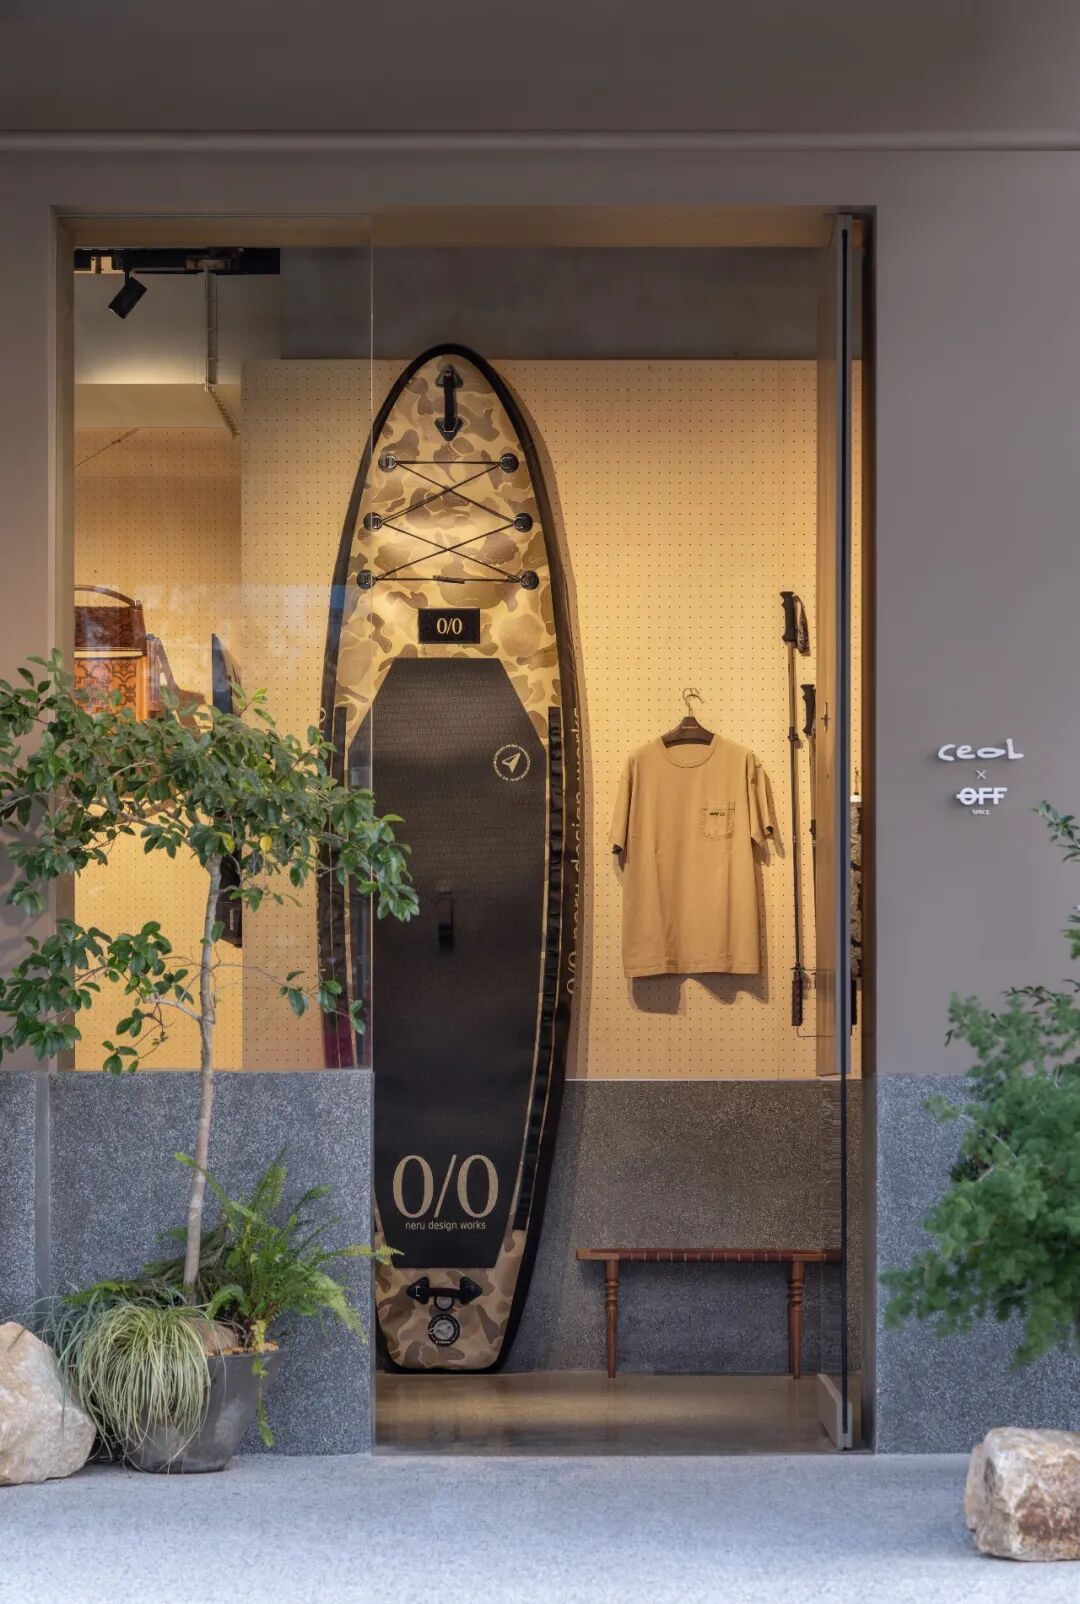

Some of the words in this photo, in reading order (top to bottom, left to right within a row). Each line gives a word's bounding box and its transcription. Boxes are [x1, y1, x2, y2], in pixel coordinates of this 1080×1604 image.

[405, 1222, 426, 1230] neru
[428, 1220, 458, 1232] design
[460, 1220, 486, 1230] works
